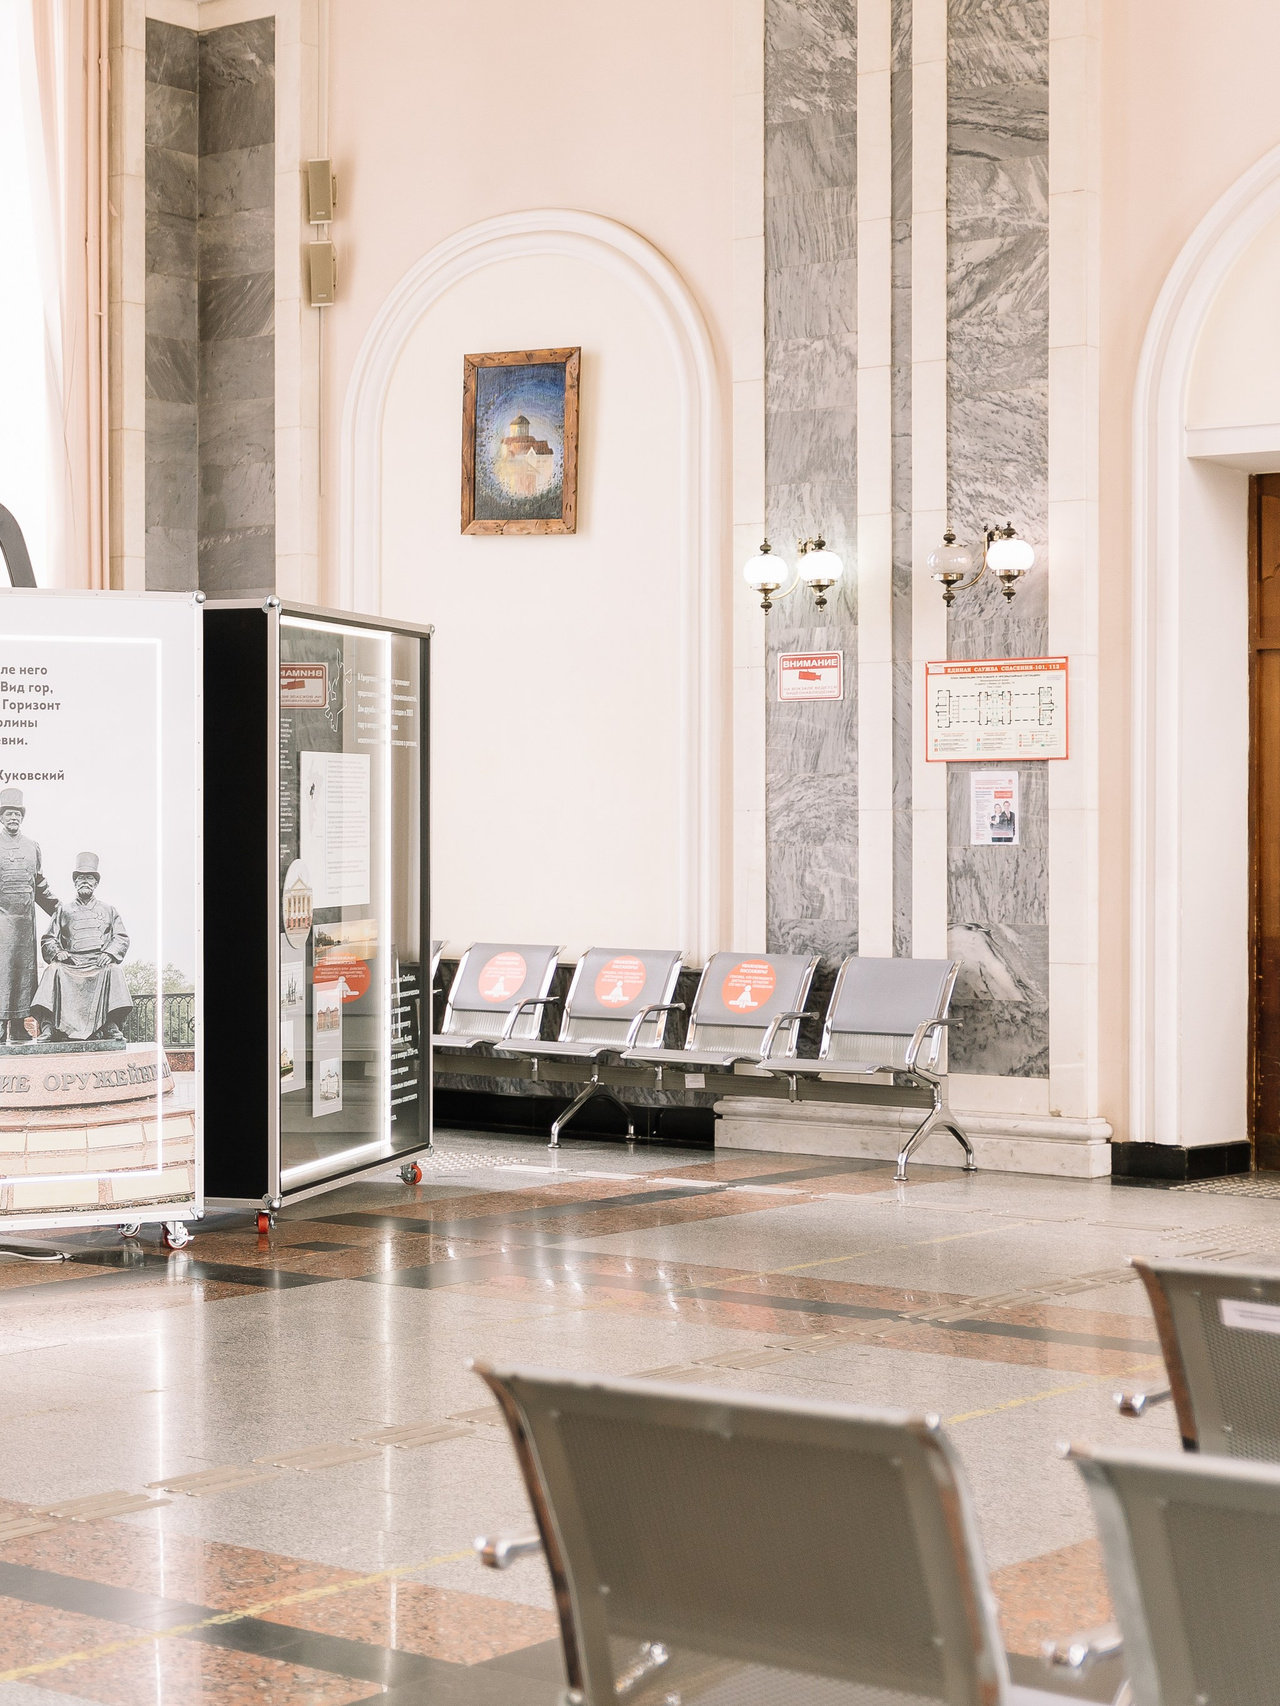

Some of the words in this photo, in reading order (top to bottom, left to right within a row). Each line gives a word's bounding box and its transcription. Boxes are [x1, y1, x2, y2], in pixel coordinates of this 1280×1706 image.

[783, 658, 838, 668] ВНИМАНИЕ
[20, 666, 48, 675] него
[0, 681, 24, 694] Вид
[28, 684, 53, 696] гор,
[2, 699, 61, 714] Горизонт
